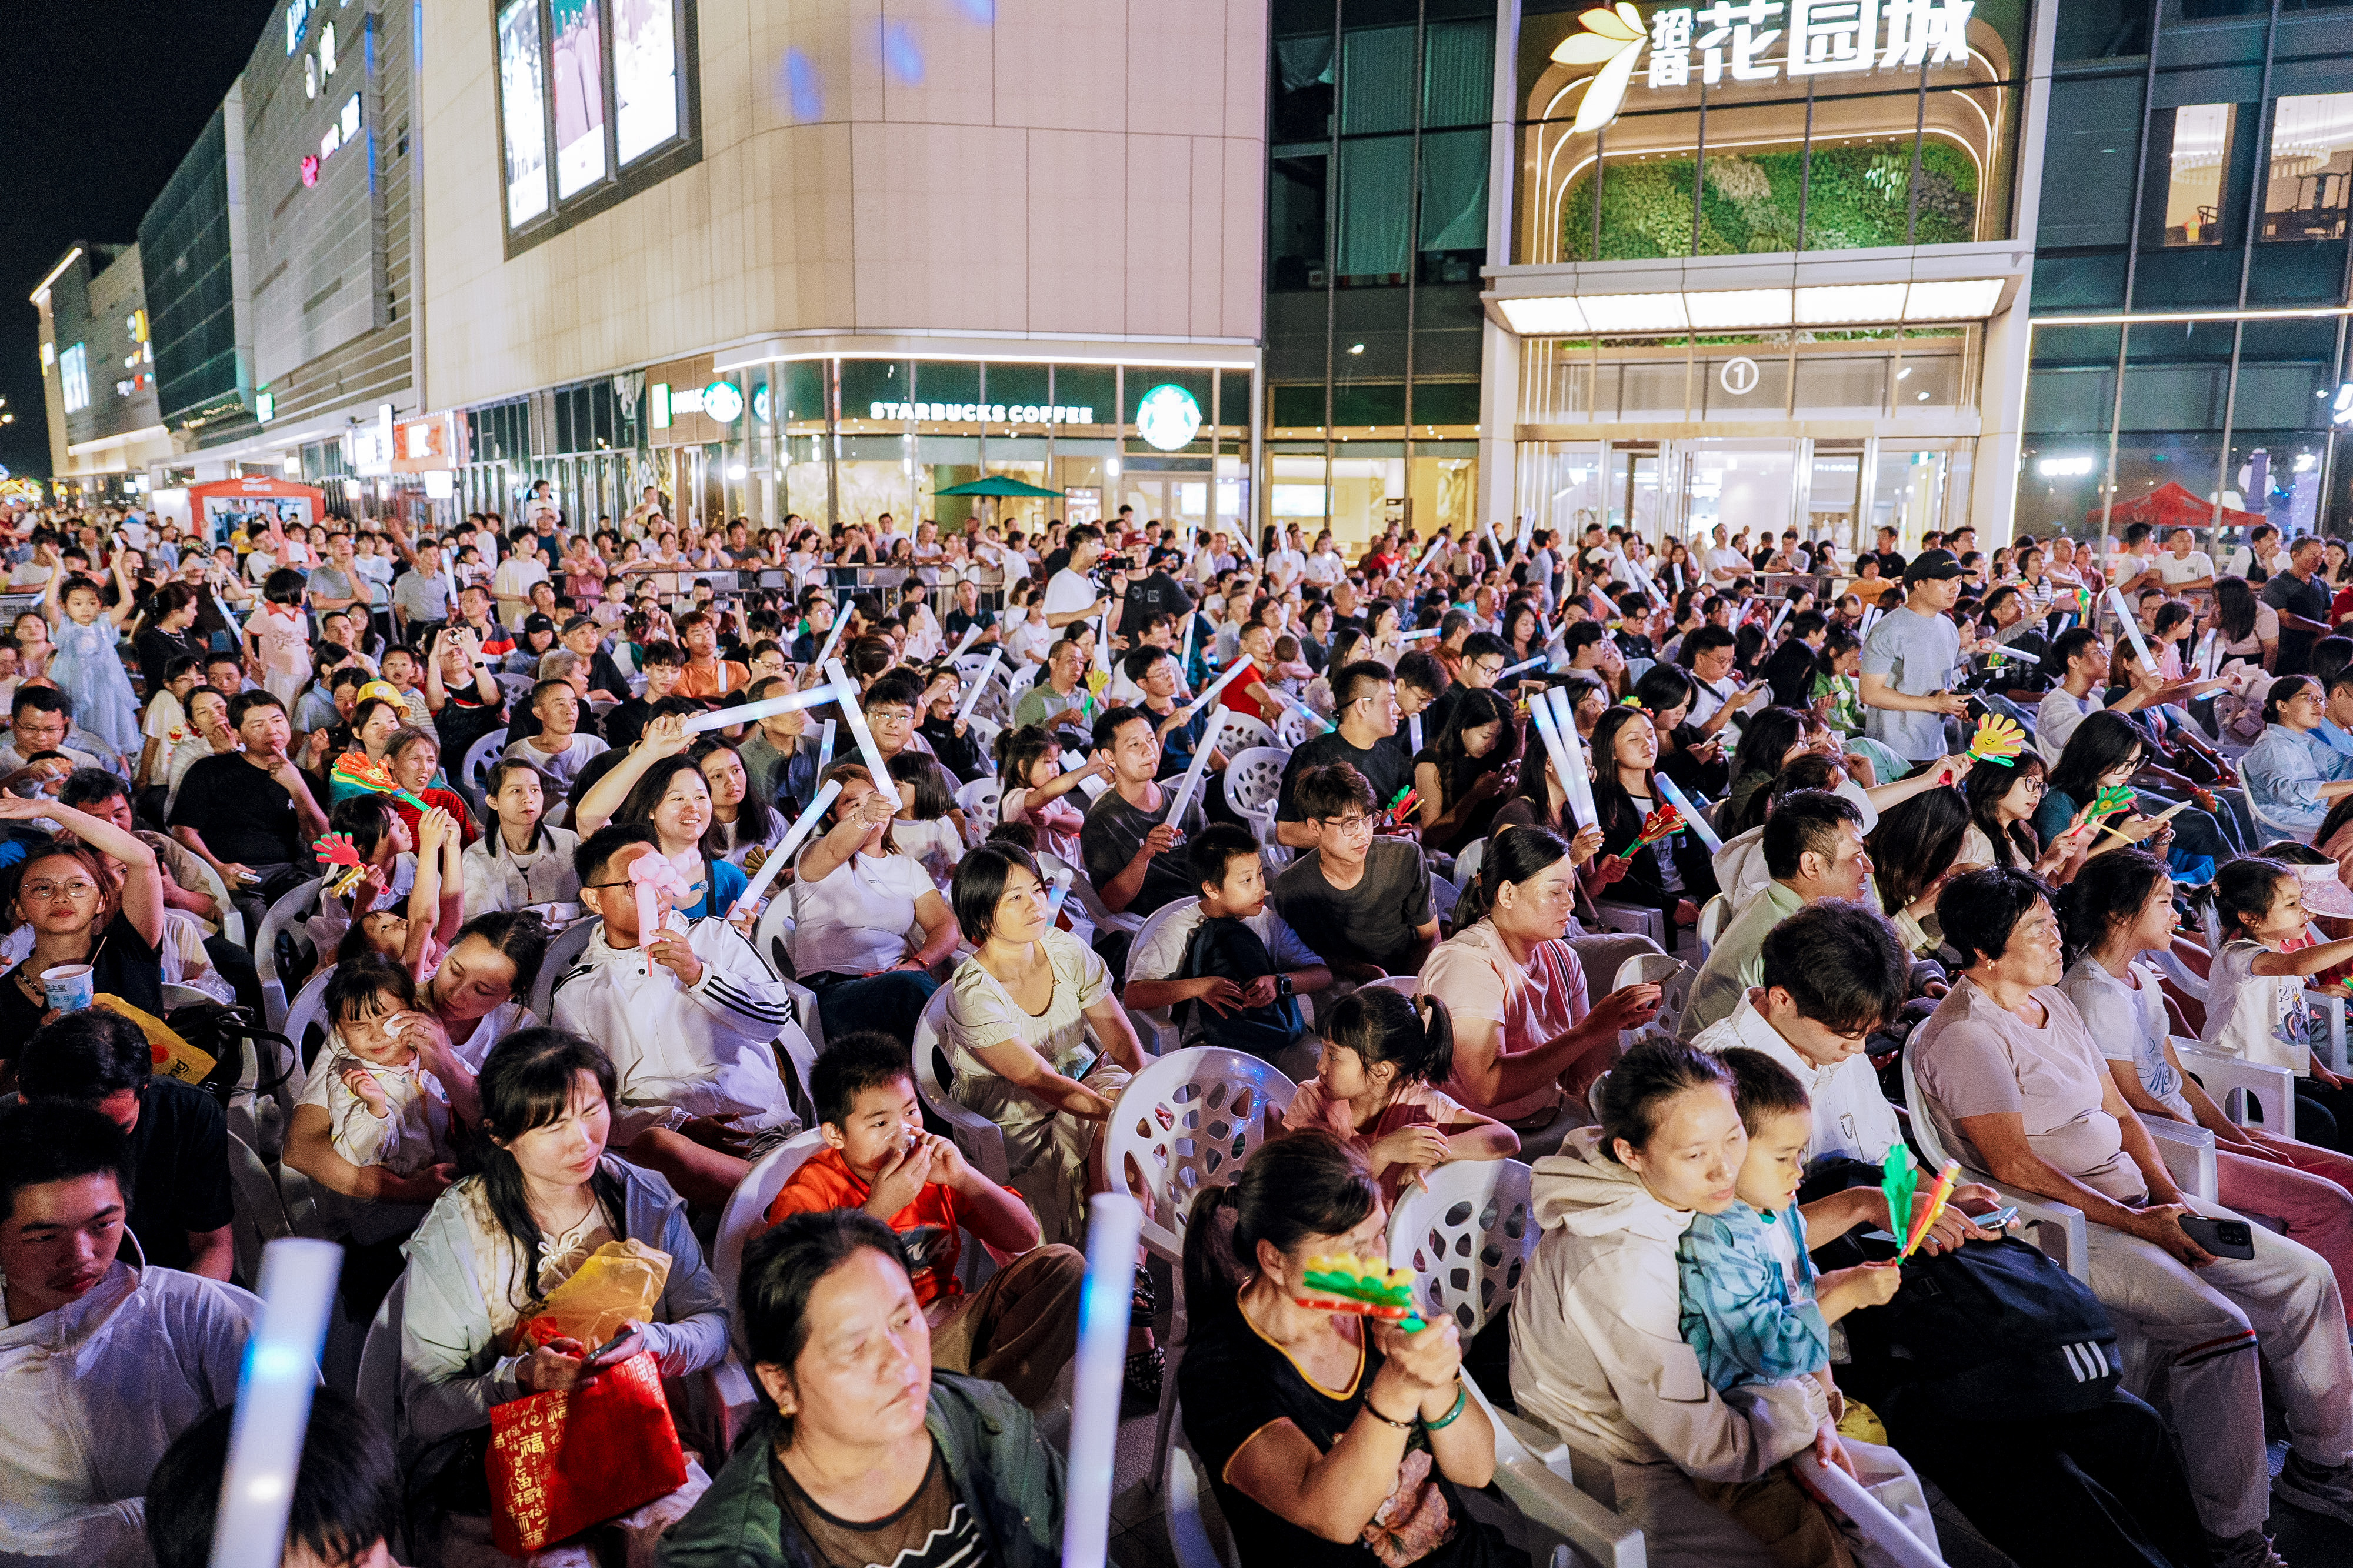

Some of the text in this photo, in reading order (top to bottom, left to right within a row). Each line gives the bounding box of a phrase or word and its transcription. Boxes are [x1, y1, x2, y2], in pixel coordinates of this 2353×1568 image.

[1648, 0, 1976, 89] 招商 花园城
[869, 402, 1094, 424] STARBUCKS COFFEE
[519, 1432, 545, 1459] 福
